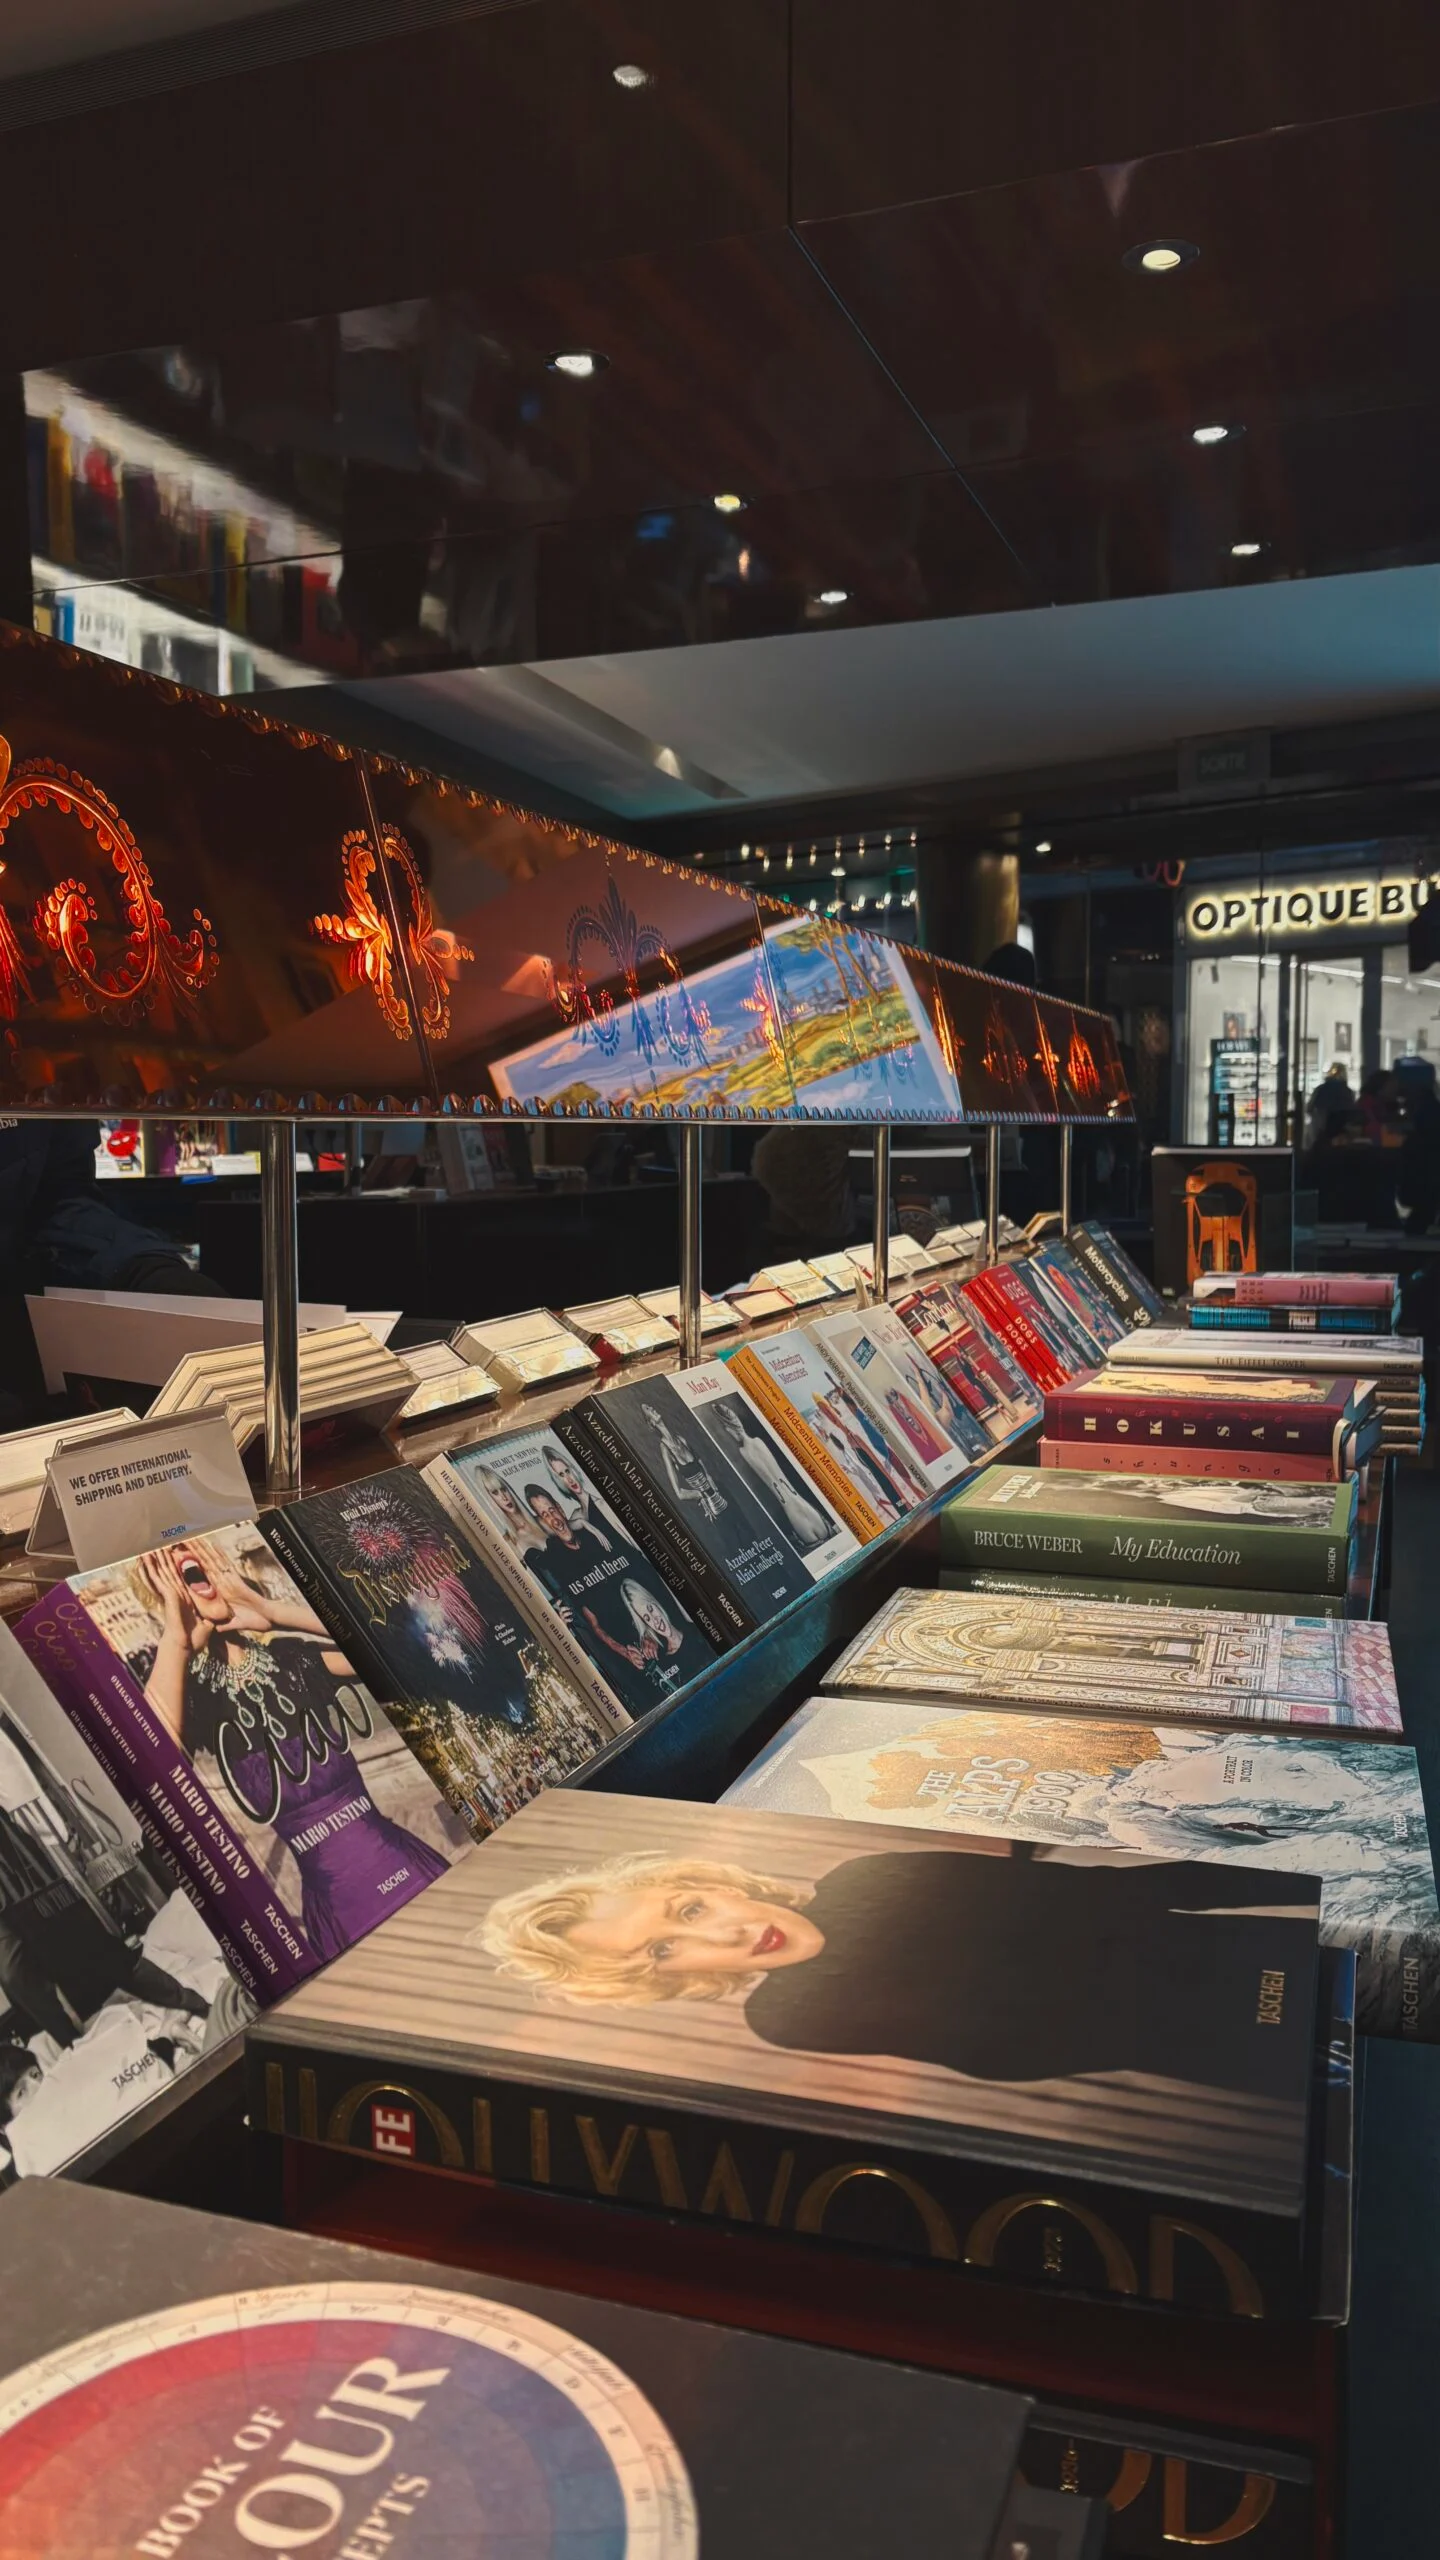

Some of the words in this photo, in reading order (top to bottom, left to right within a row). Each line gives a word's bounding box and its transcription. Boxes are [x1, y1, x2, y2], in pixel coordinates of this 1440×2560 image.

[1192, 886, 1370, 932] OPTIQUE
[1084, 1246, 1129, 1302] Motorcycles
[910, 1301, 953, 1330] London
[1005, 1323, 1029, 1351] DOGS
[1014, 1316, 1038, 1344] DOGS
[816, 1343, 831, 1362] ANDY
[1272, 1358, 1308, 1370] TOWER
[686, 1380, 708, 1396] Man
[703, 1376, 723, 1392] Ray
[69, 1475, 87, 1491] WE
[88, 1466, 120, 1486] OFFER
[121, 1448, 192, 1477] INTERNATIONAL
[490, 1455, 518, 1470] HELMUT
[514, 1446, 541, 1461] NEWTON
[501, 1465, 520, 1479] ALICE
[517, 1457, 543, 1472] SPRINGS
[769, 1417, 809, 1469] Midcentury
[806, 1464, 840, 1507] Memories
[783, 1406, 823, 1460] Midcentury
[819, 1453, 853, 1498] Memories
[74, 1486, 123, 1507] SHIPPING
[125, 1477, 146, 1494] AND
[148, 1463, 192, 1487] DELIVERY.
[583, 1411, 622, 1459] Azzedine
[619, 1461, 643, 1491] Alaïa
[641, 1488, 666, 1519] Peter
[664, 1518, 707, 1577] Lindbergh
[908, 1464, 929, 1490] TASCHEN
[340, 1507, 361, 1523] Walt
[561, 1425, 600, 1474] Azzedine
[619, 1502, 644, 1533] Peter
[642, 1533, 685, 1592] Lindbergh
[854, 1501, 877, 1528] TASCHEN
[160, 1525, 186, 1539] TASCHEN
[974, 1530, 1025, 1549] BRUCE
[1026, 1536, 1083, 1554] WEBER
[1110, 1536, 1142, 1563] My
[1144, 1538, 1243, 1566] Education
[269, 1528, 286, 1550] Walt
[283, 1548, 309, 1583] Disney's
[440, 1469, 467, 1504] HELMUT
[464, 1501, 490, 1537] NEWTON
[491, 1543, 513, 1570] ALICE
[508, 1566, 533, 1600] SPRINGS
[540, 1611, 552, 1625] us
[547, 1626, 564, 1645] and
[562, 1642, 581, 1666] them
[568, 1580, 586, 1596] us
[583, 1564, 604, 1587] and
[601, 1554, 631, 1576] them
[725, 1543, 761, 1574] Azzedine
[753, 1534, 775, 1556] Peter
[753, 1547, 786, 1576] Lindbergh
[1328, 1547, 1338, 1583] TASCHEN
[336, 1532, 471, 1627] Disneyland
[695, 1607, 723, 1643] TASCHEN
[717, 1593, 745, 1628] TASCHEN
[88, 1692, 113, 1727] OMAGGIO
[110, 1674, 136, 1710] OMAGGIO
[590, 1680, 620, 1720] TASCHEN
[218, 1683, 375, 1825] Ciao
[917, 1768, 958, 1798] THE
[945, 1755, 1032, 1825] ALPS
[1014, 1770, 1079, 1820] 1900
[145, 1781, 186, 1835] MARIO
[180, 1831, 228, 1896] TESTINO
[168, 1764, 209, 1818] MARIO
[203, 1813, 251, 1881] TESTINO
[290, 1821, 331, 1856] MARIO
[325, 1795, 372, 1833] TESTINO
[129, 1799, 165, 1849] MARIO
[160, 1847, 206, 1912] TESTINO
[376, 1867, 410, 1896] TASCHEN
[239, 1918, 279, 1976] TASCHEN
[263, 1902, 304, 1961] TASCHEN
[219, 1934, 257, 1990] TASCHEN
[1255, 1969, 1285, 2025] TASCHEN
[1402, 1956, 1420, 2033] TASCHEN
[375, 2108, 413, 2156] FE
[234, 2356, 451, 2560] OUR
[136, 2455, 249, 2559] BOOK
[233, 2404, 285, 2452] OF
